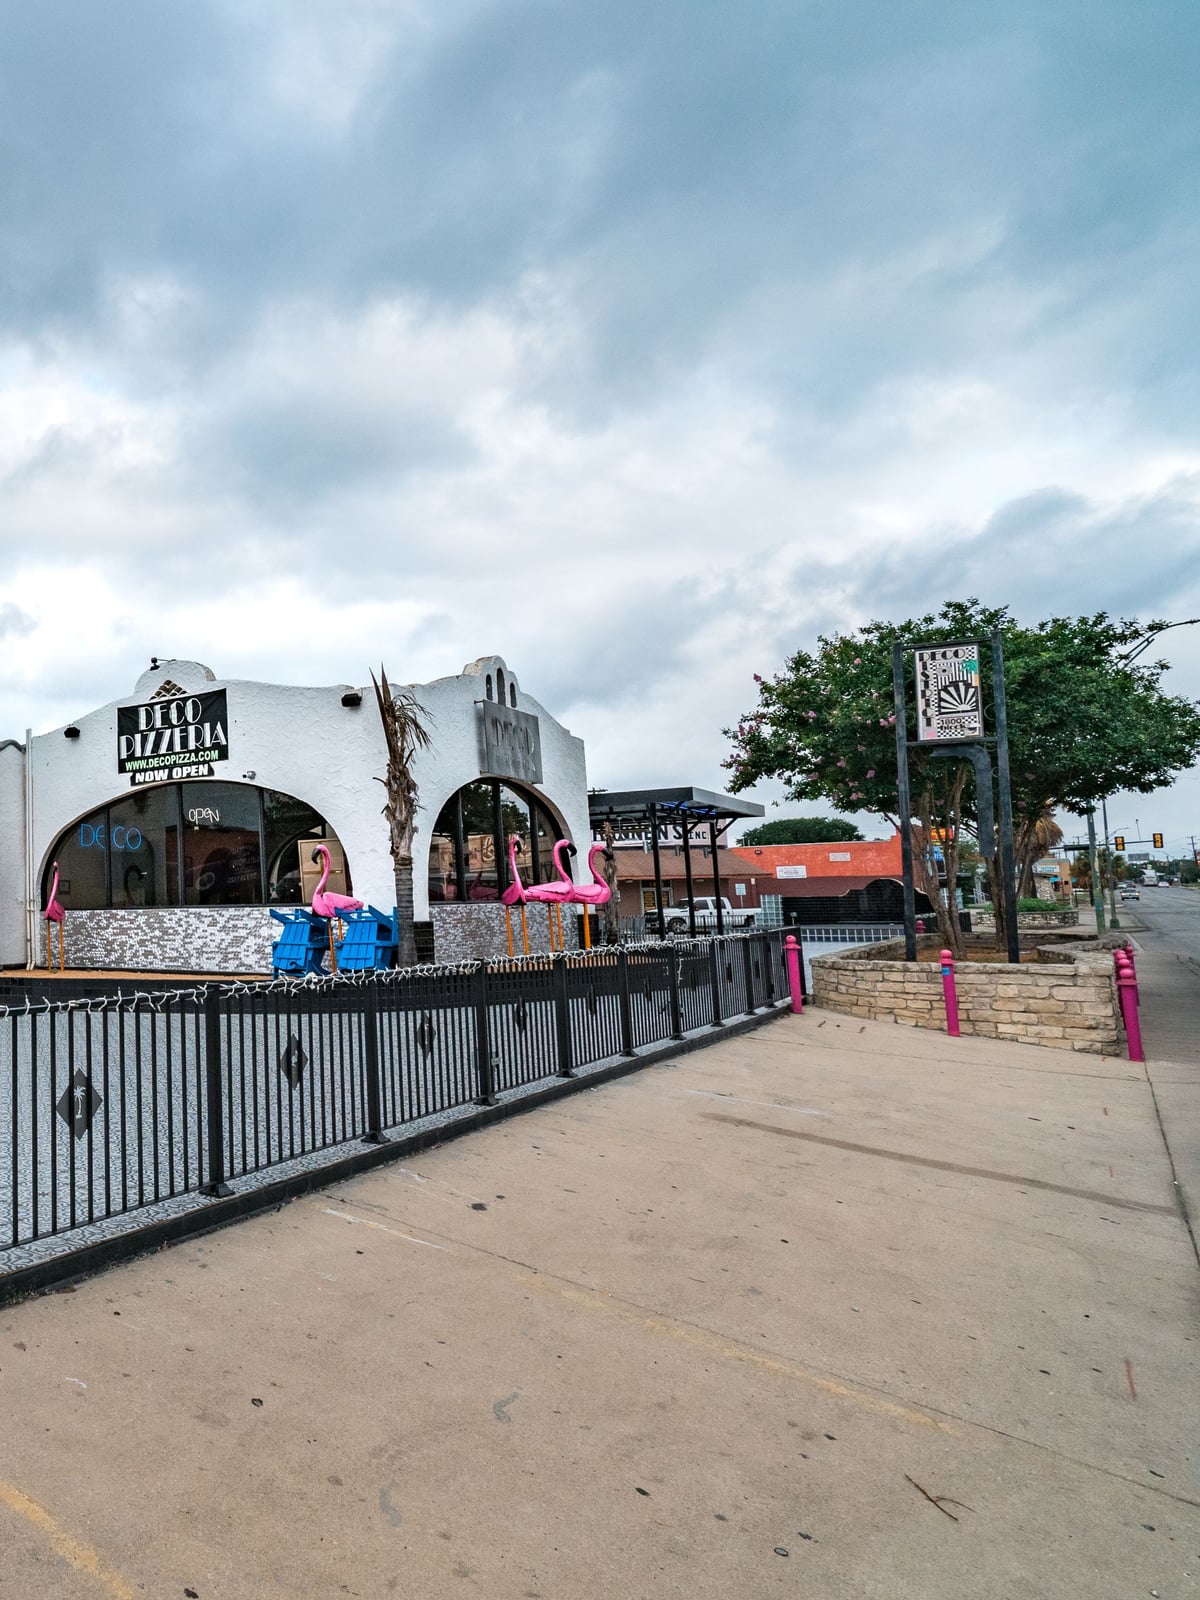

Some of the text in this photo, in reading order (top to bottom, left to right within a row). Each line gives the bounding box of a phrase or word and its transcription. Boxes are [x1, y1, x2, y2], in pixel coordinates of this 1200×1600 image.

[918, 648, 966, 661] DECO
[138, 697, 202, 731] DECO
[120, 721, 228, 760] PIZZERIA
[125, 750, 219, 772] WWW.DECOPIZZA.COM
[135, 763, 209, 783] NOW OPEN
[80, 823, 143, 850] DECO
